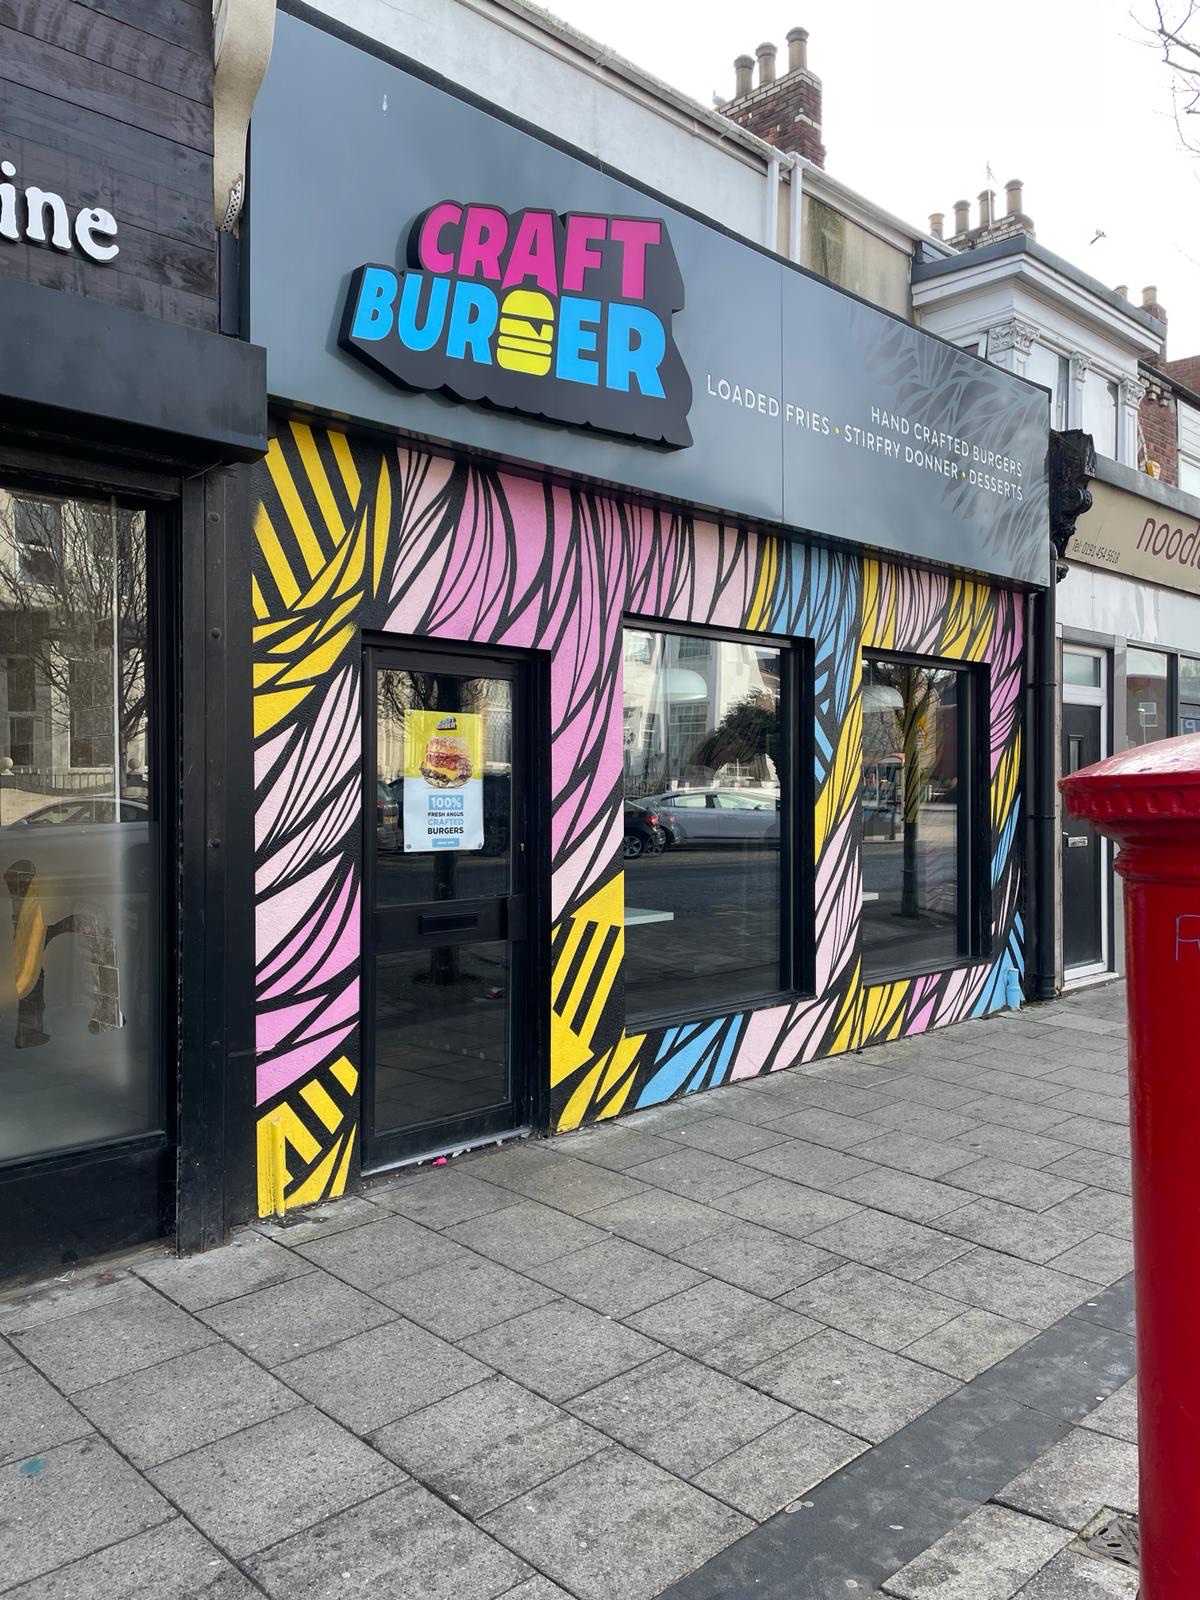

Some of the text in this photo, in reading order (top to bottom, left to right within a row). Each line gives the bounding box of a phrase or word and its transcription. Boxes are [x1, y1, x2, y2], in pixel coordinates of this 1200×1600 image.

[419, 202, 662, 300] CRAFT
[351, 266, 667, 399] BURGER
[706, 374, 1023, 501] LOADED FRIES STIRFRY DONNER DESSERTS
[871, 405, 1023, 477] HAND CRAFTED BURGERS
[427, 818, 464, 826] CRAFTED
[427, 827, 464, 835] BURGERS
[431, 797, 462, 809] 100%
